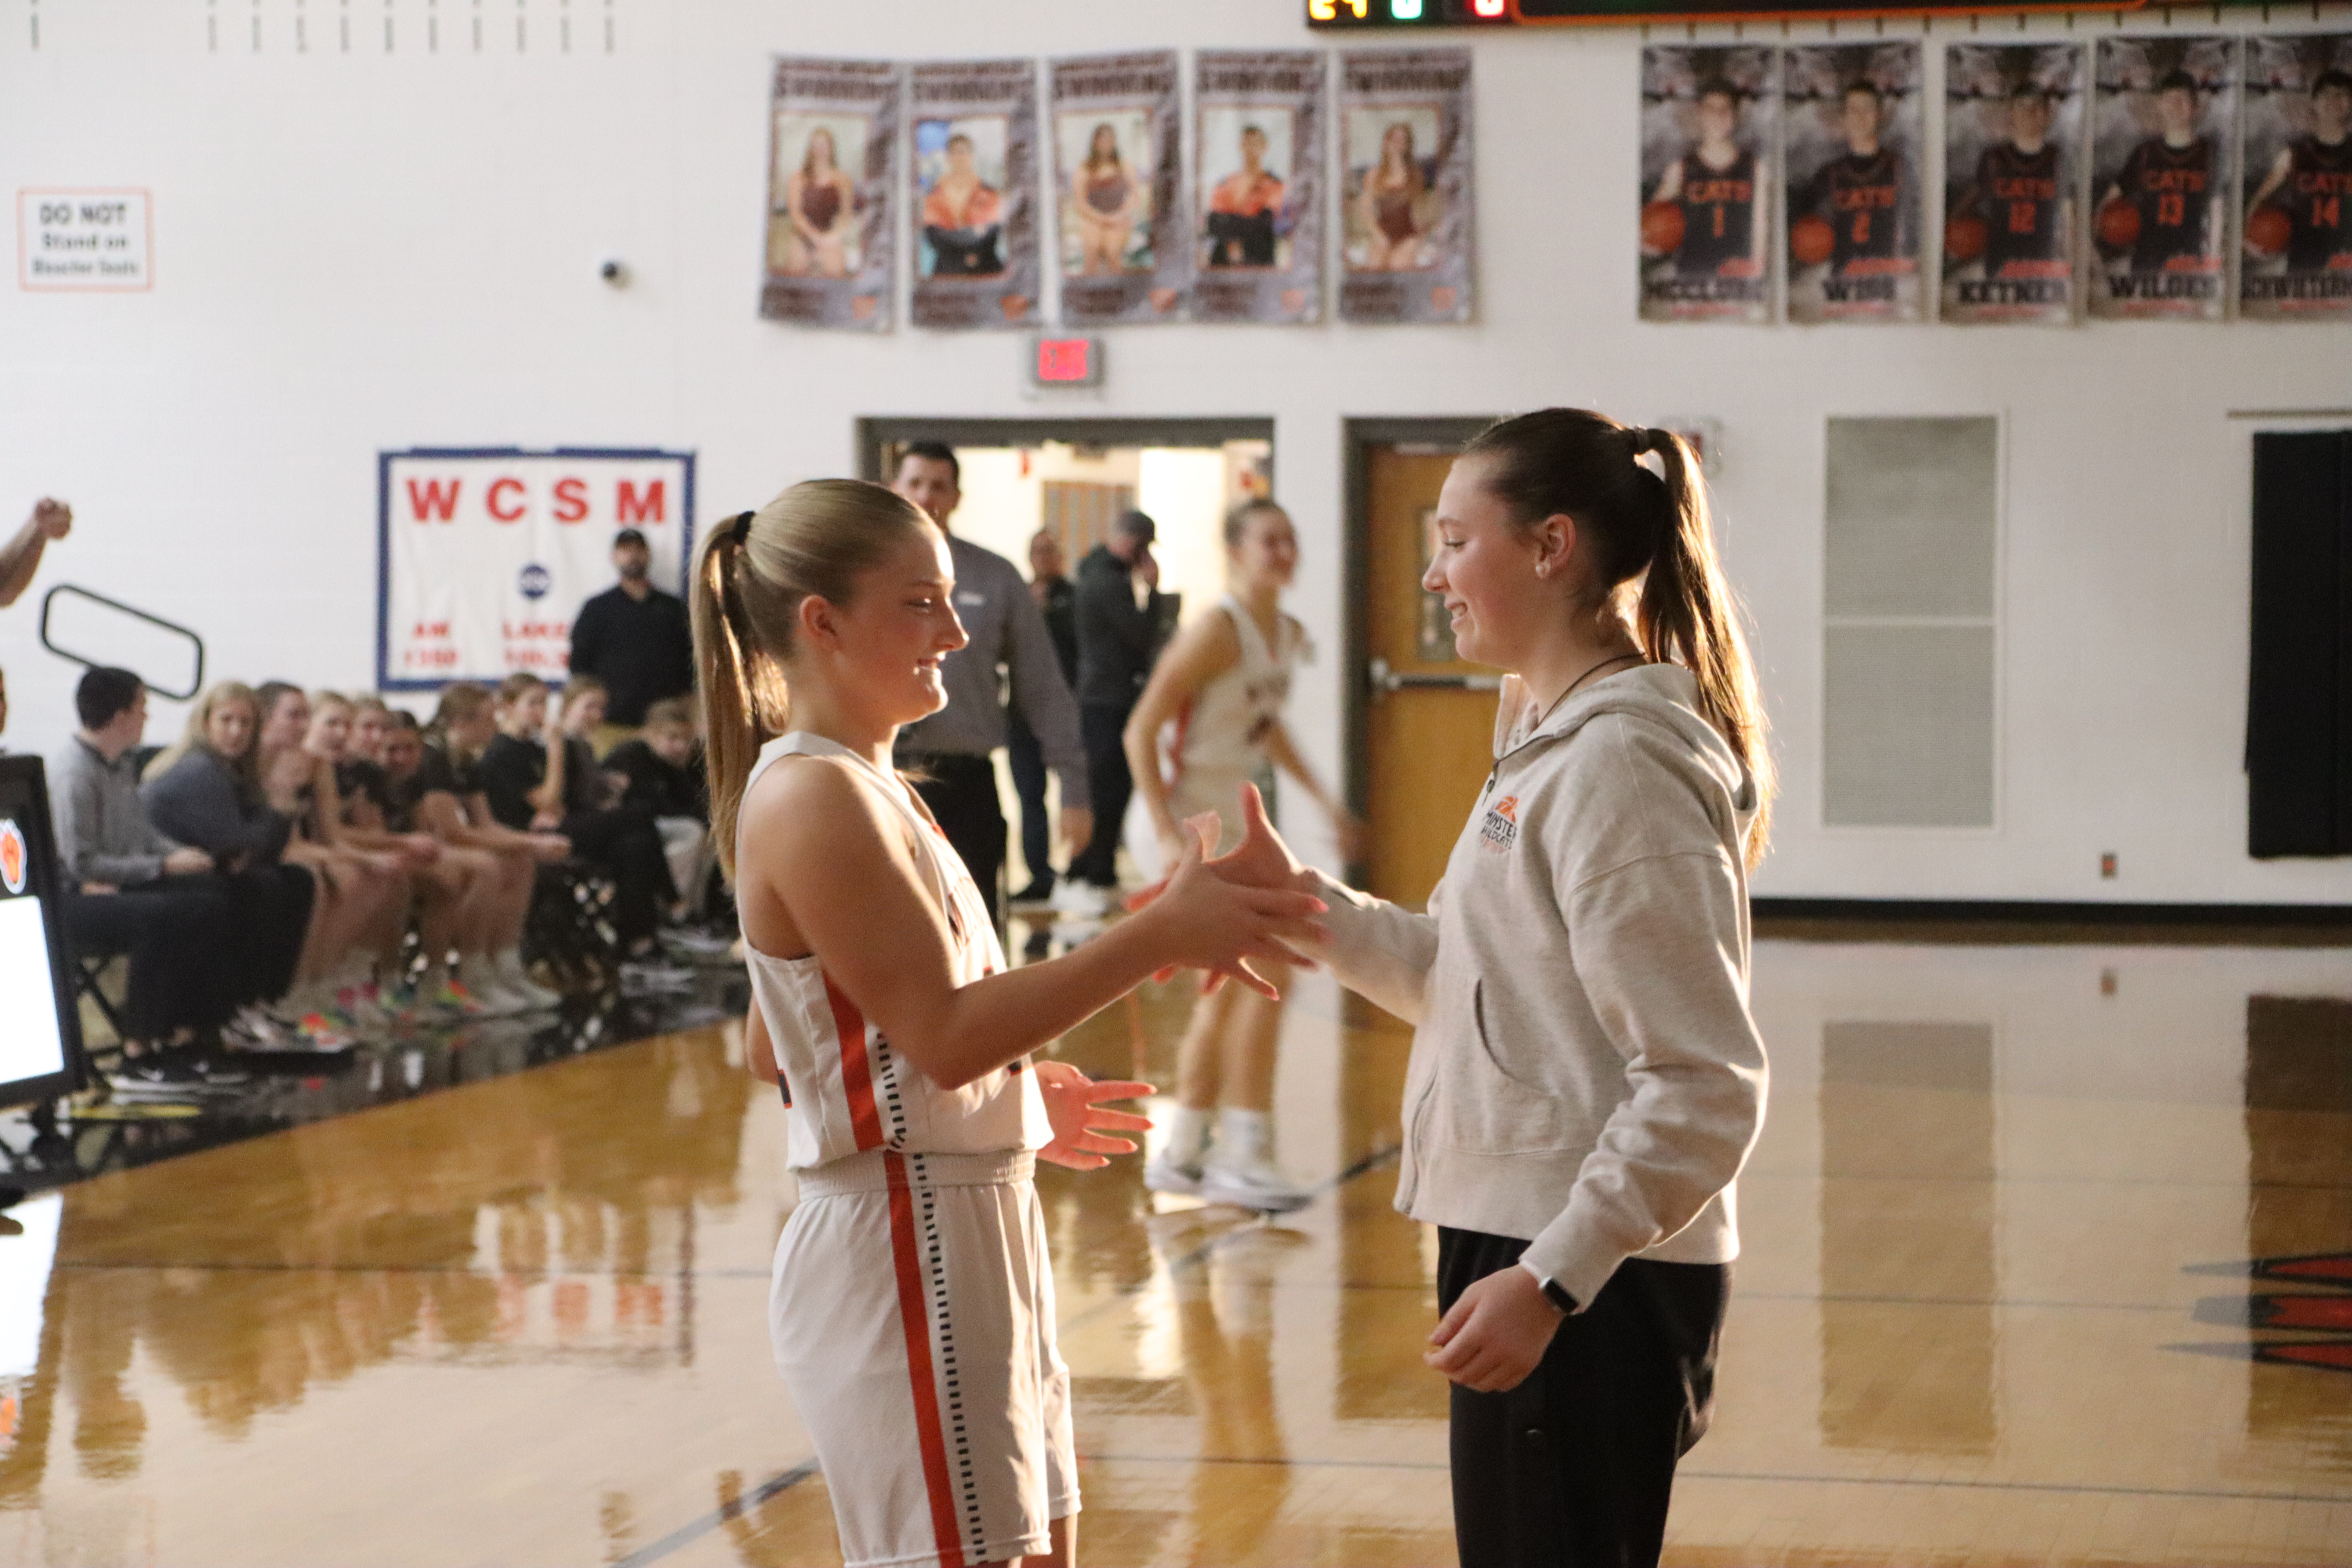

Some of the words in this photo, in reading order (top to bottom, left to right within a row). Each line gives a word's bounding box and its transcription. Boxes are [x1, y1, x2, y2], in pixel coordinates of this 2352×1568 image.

[40, 202, 71, 225] DO
[81, 201, 126, 225] NOT
[1713, 207, 1724, 237] 1
[2158, 194, 2184, 225] 13
[2314, 198, 2339, 227] 14
[407, 477, 666, 524] WCSM
